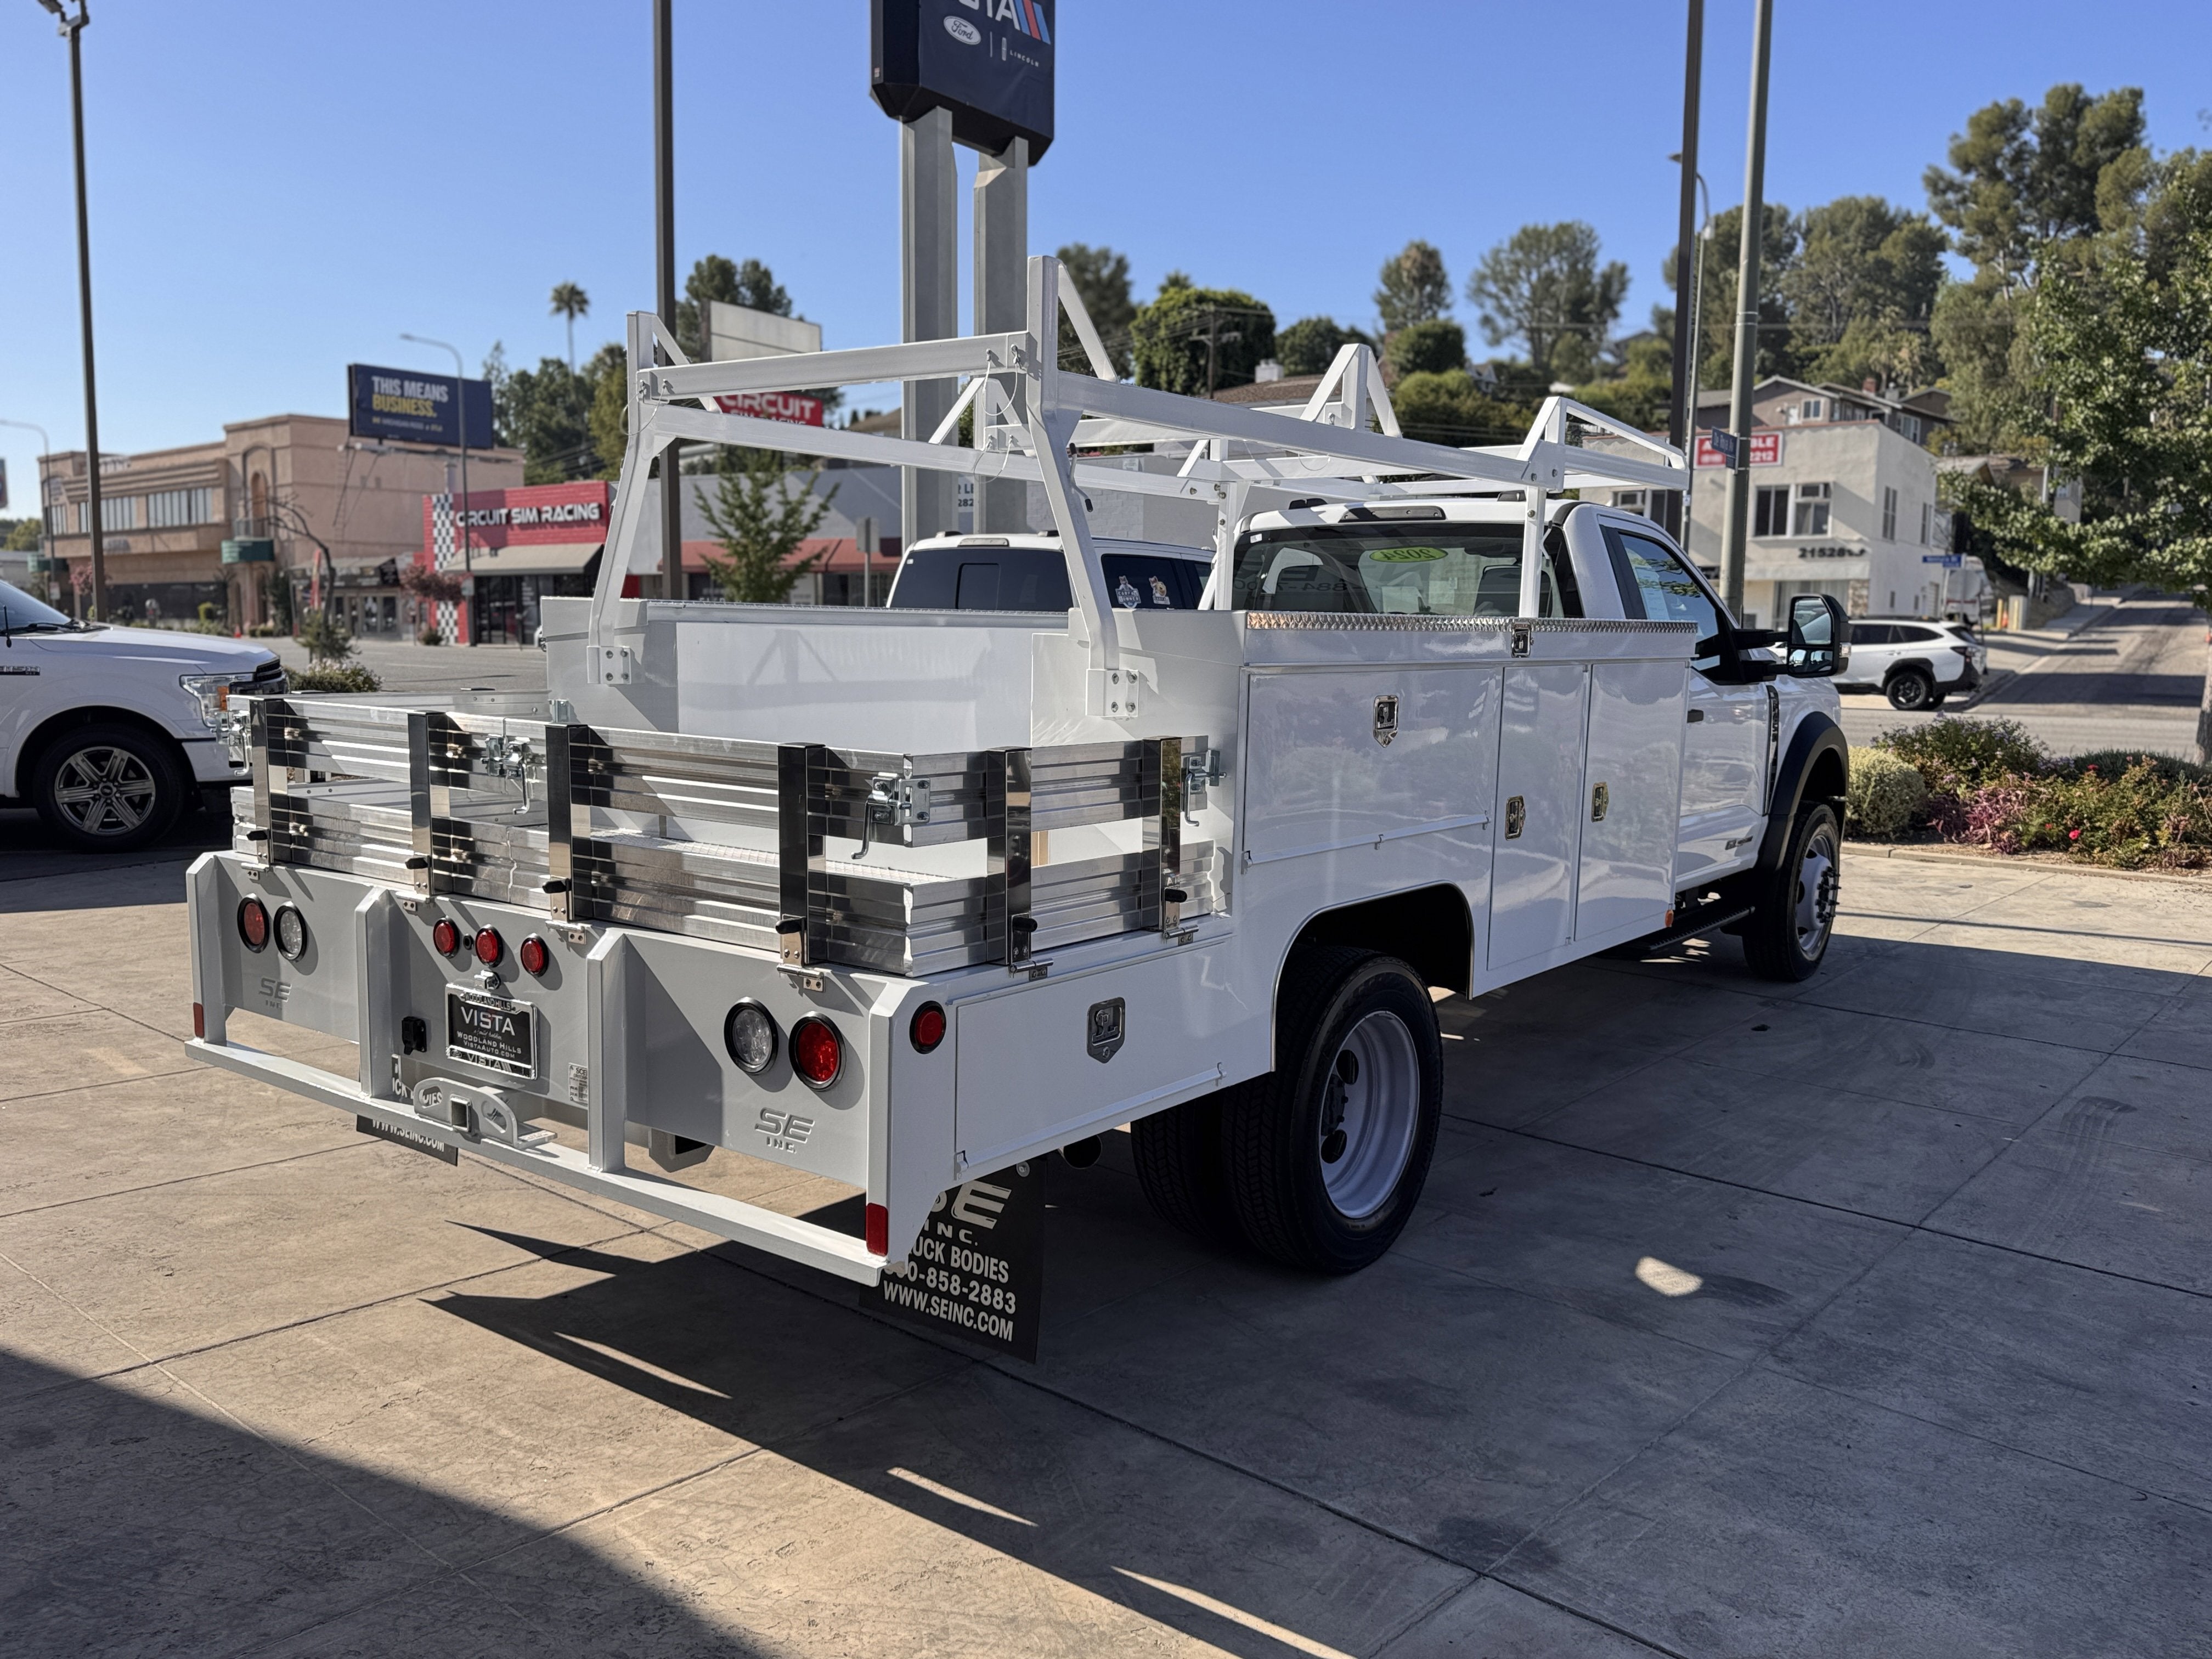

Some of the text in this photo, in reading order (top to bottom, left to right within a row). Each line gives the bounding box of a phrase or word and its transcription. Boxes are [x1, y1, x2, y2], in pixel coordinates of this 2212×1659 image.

[951, 20, 973, 40] Ford
[1009, 50, 1039, 67] LINCOLN
[371, 375, 449, 403] THIS MEANS
[373, 393, 438, 418] BUSINESS.
[456, 502, 600, 527] CRCUIT SIM RACING
[259, 978, 292, 1003] SE
[465, 992, 512, 1011] WOODLAND HILLS
[461, 1006, 516, 1036] VISTA
[457, 1030, 497, 1047] WOODLAND
[499, 1042, 522, 1054] HILLS
[467, 1052, 501, 1070] VISTA
[755, 1107, 815, 1144] SE
[766, 1136, 797, 1154] INC.
[924, 1218, 978, 1246] INC.
[950, 1245, 1009, 1284] BODIES
[884, 1261, 1016, 1314] 0-858-2883
[883, 1279, 1014, 1342] WWW.SEINC.COM
